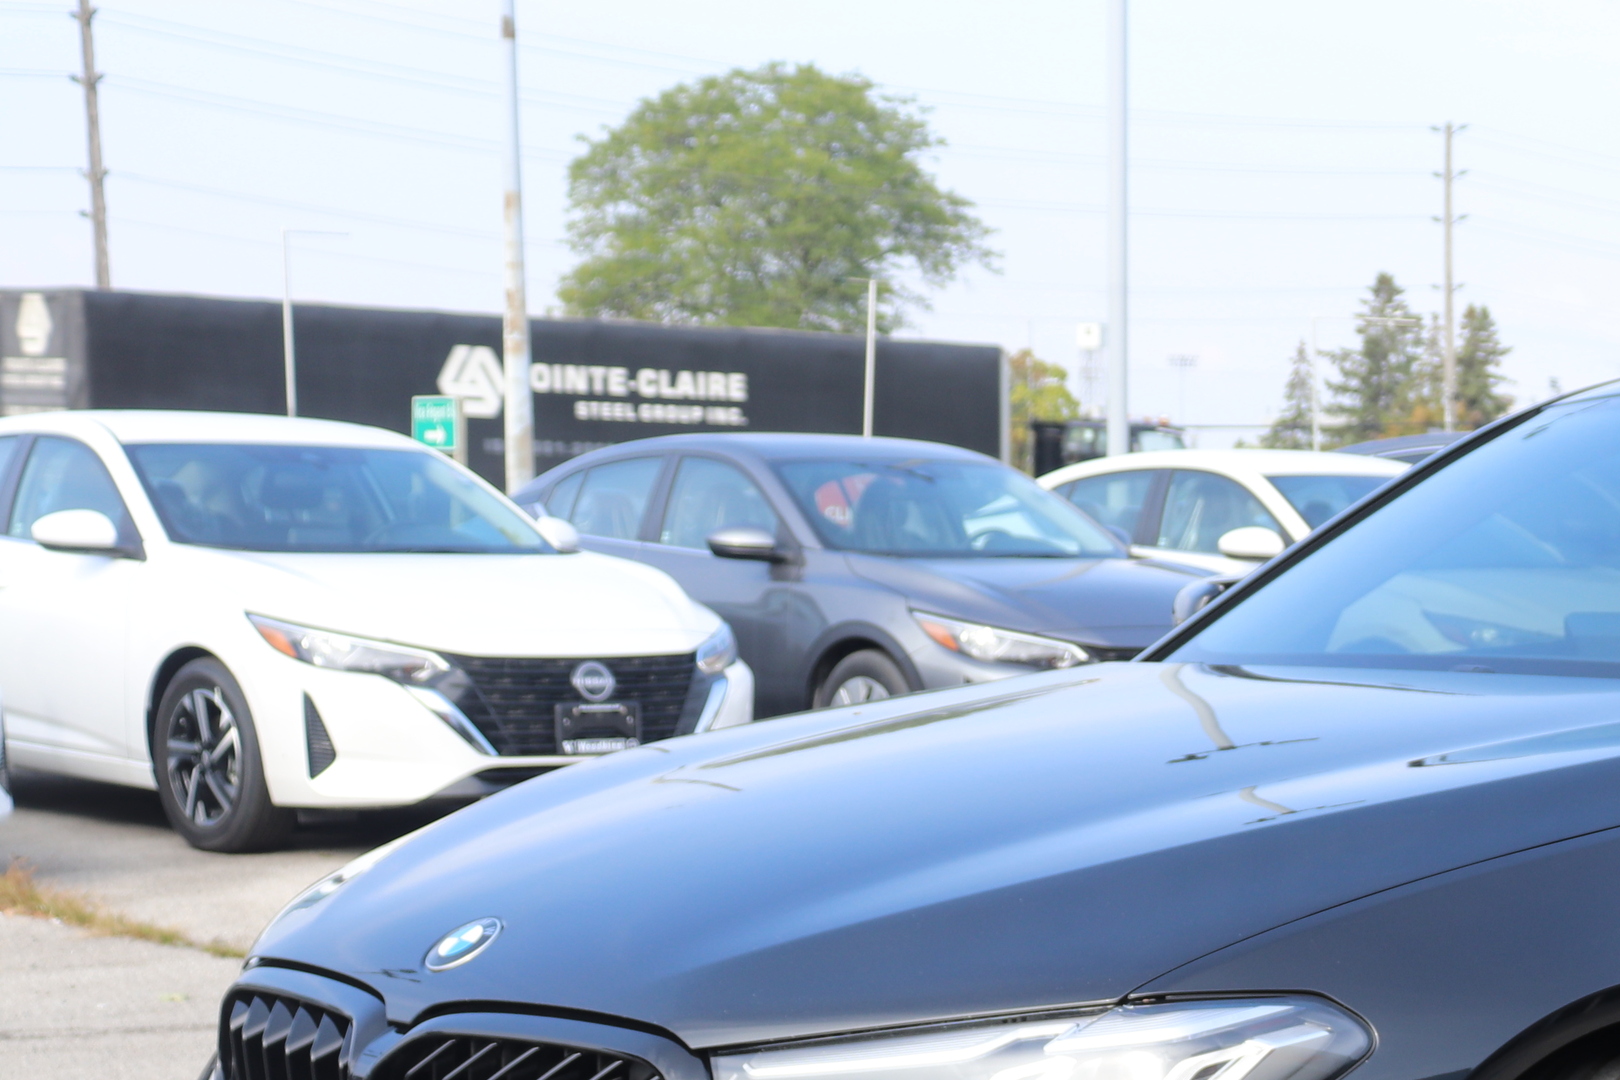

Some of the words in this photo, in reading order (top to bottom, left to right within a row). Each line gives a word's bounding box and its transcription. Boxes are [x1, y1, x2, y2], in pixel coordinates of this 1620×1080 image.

[529, 362, 748, 402] OINTE-CLAIRE
[574, 400, 637, 422] STEEL
[638, 403, 704, 424] GROUP
